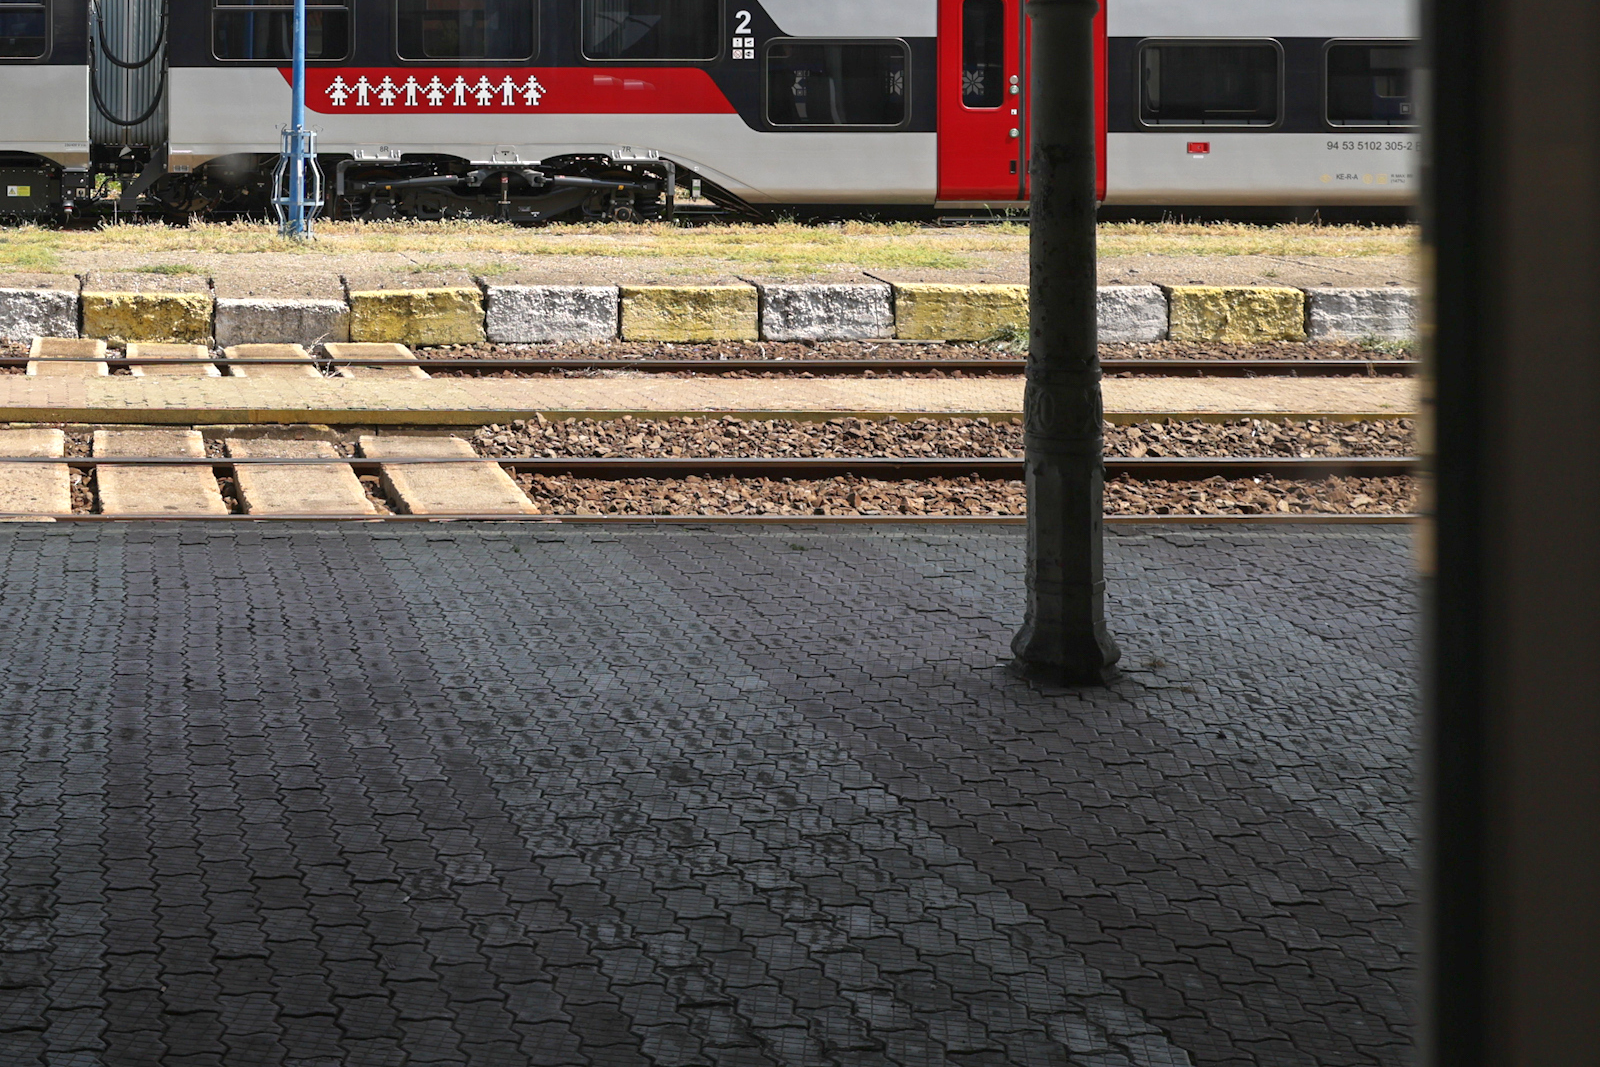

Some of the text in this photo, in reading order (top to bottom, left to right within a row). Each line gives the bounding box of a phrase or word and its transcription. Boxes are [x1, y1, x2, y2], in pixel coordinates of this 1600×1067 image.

[734, 10, 752, 35] 2
[1326, 141, 1339, 151] 94
[1342, 141, 1355, 151] 53
[1357, 141, 1382, 151] 5102
[1385, 141, 1413, 151] 305-2
